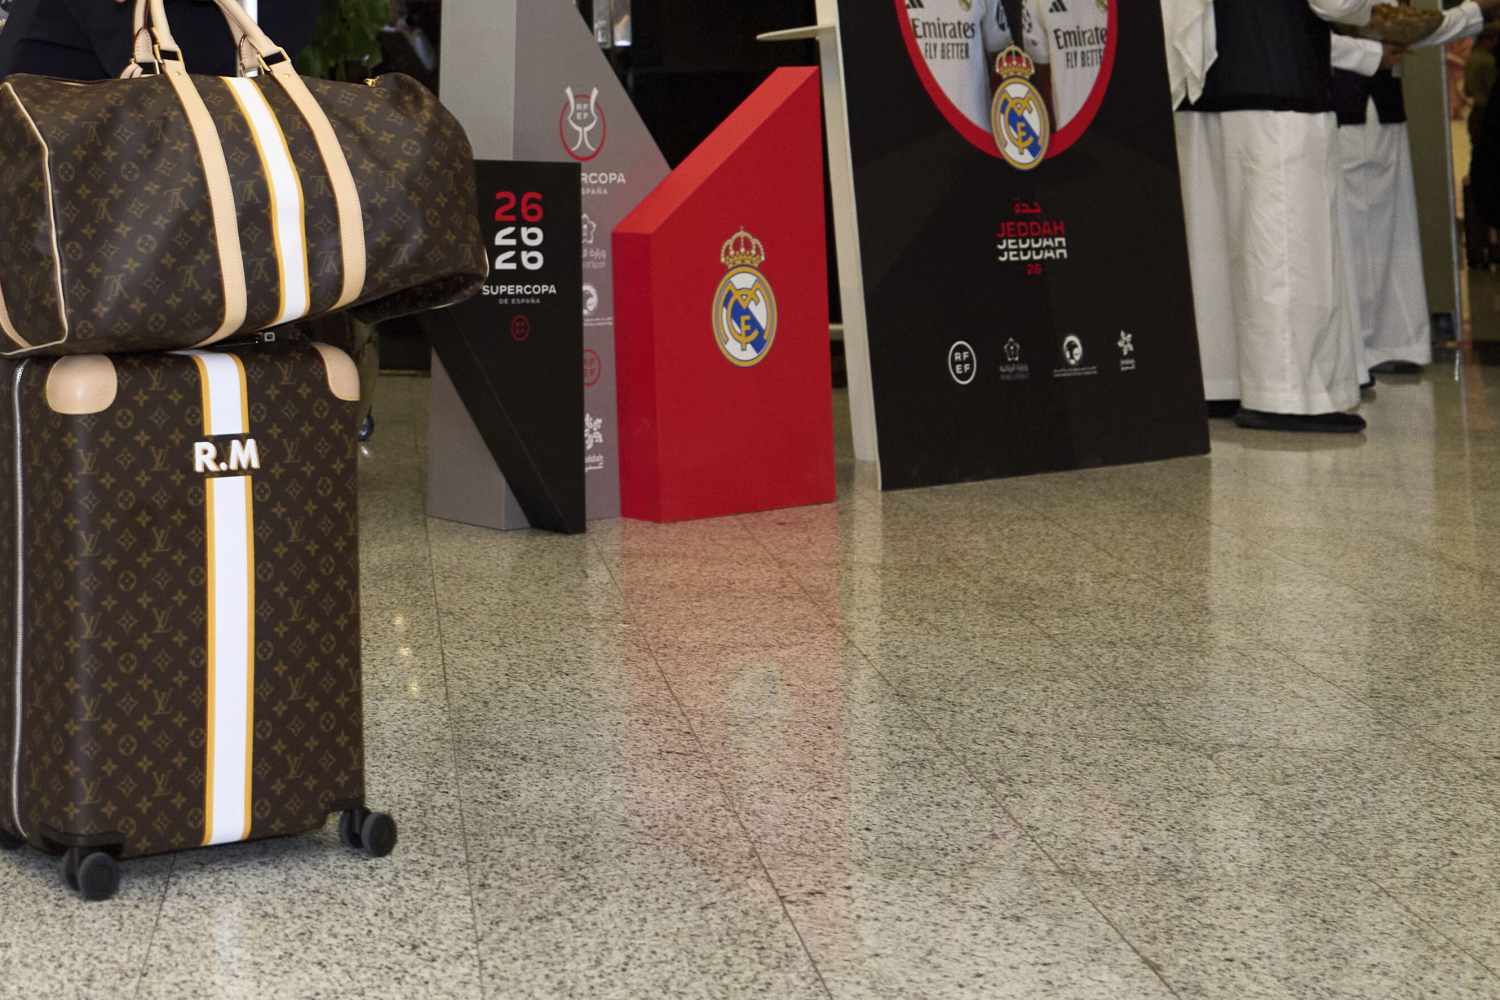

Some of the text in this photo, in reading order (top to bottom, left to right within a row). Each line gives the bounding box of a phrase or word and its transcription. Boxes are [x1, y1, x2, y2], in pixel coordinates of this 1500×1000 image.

[912, 17, 976, 40] Emirates
[1053, 25, 1107, 50] Emirate
[924, 42, 970, 60] FLY BETTER
[1066, 51, 1078, 68] FLY
[494, 191, 544, 222] 26
[996, 220, 1065, 238] JEDDAH
[1026, 263, 1042, 275] 26
[482, 284, 557, 295] SUPERCOPA
[511, 296, 541, 304] ESPAÑA
[954, 351, 969, 361] RF
[955, 364, 970, 374] EF
[194, 438, 261, 473] R.M
